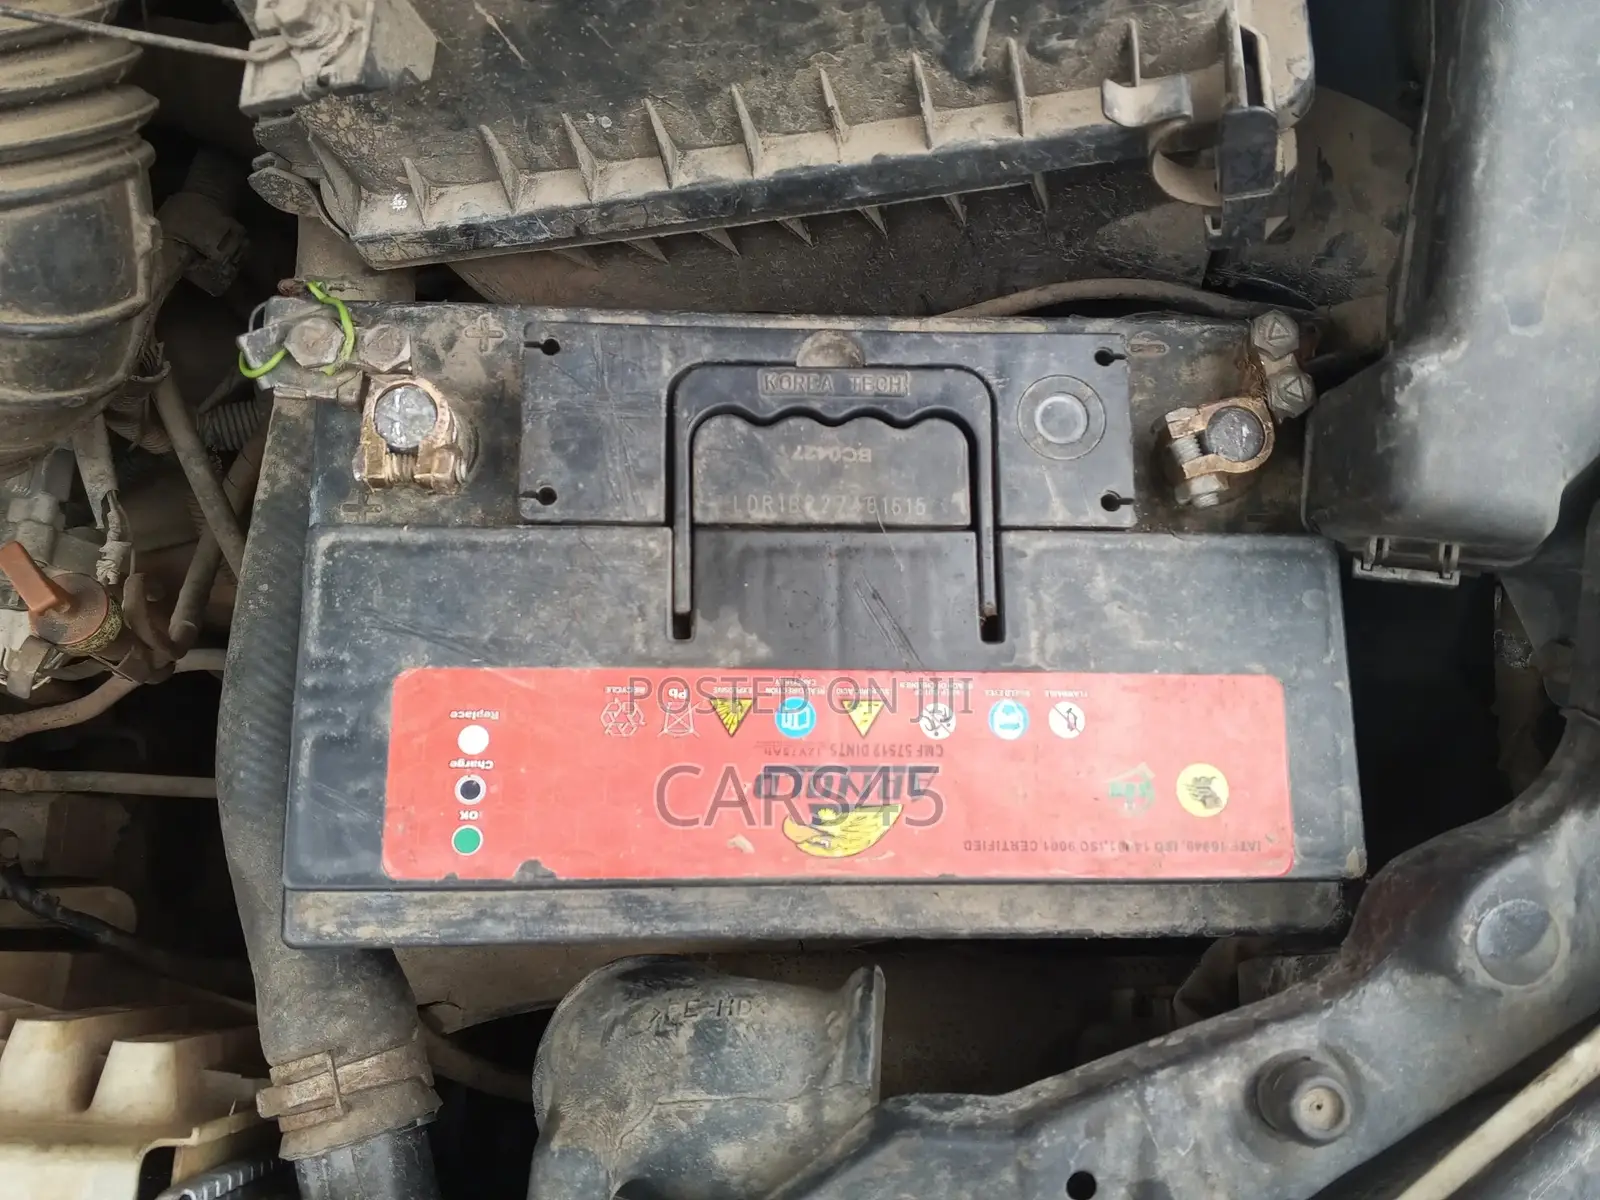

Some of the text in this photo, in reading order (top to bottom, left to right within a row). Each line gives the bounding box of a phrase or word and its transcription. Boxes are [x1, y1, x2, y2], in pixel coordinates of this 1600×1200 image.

[765, 374, 906, 394] KOREA TECH
[668, 687, 688, 700] Pb
[449, 709, 500, 720] Replace
[449, 758, 494, 770] Charge
[459, 810, 479, 820] OK
[963, 839, 1038, 853] CERTIFIED
